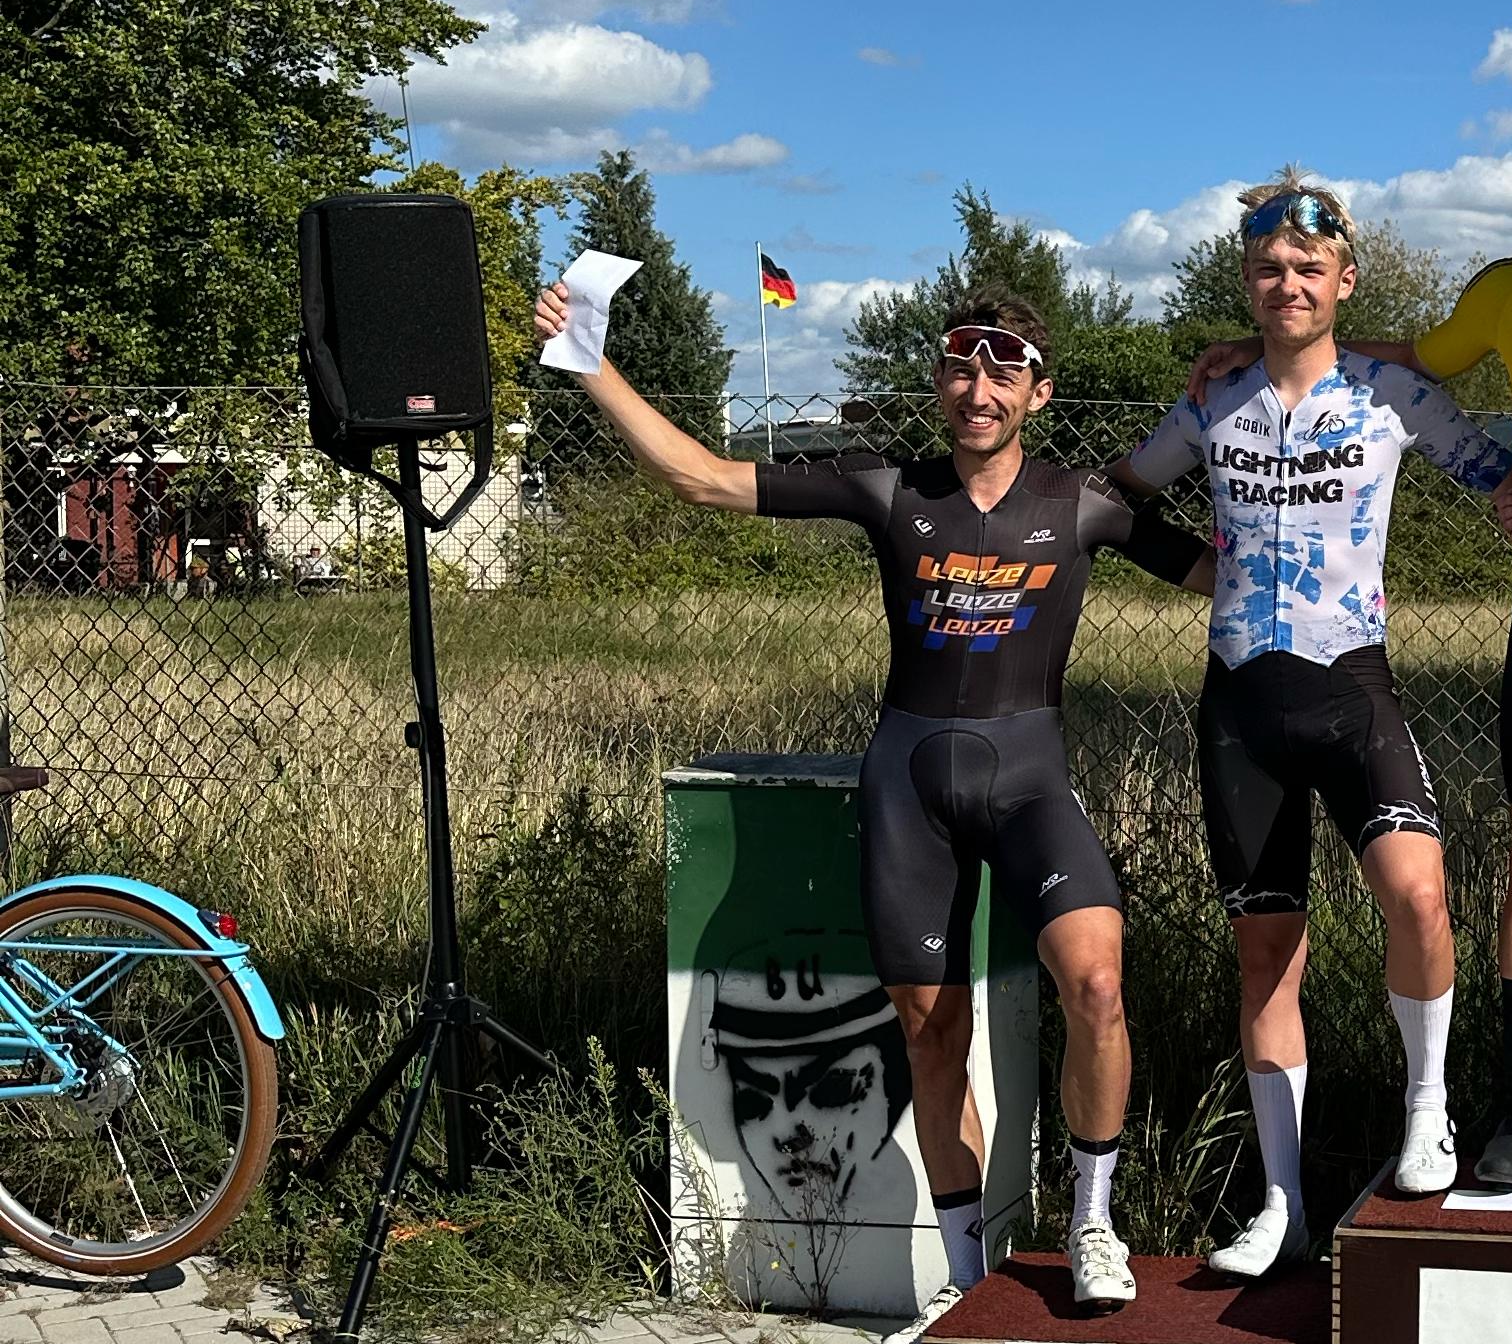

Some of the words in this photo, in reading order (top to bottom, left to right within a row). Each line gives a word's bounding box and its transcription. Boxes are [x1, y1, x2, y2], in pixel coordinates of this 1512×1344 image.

[1234, 416, 1271, 438] GOBIK
[1210, 441, 1364, 481] LIGHTNING
[1228, 478, 1344, 507] RACING
[930, 562, 1026, 586] Leeze
[930, 589, 1021, 611] Leeze
[928, 615, 1015, 636] Leeze
